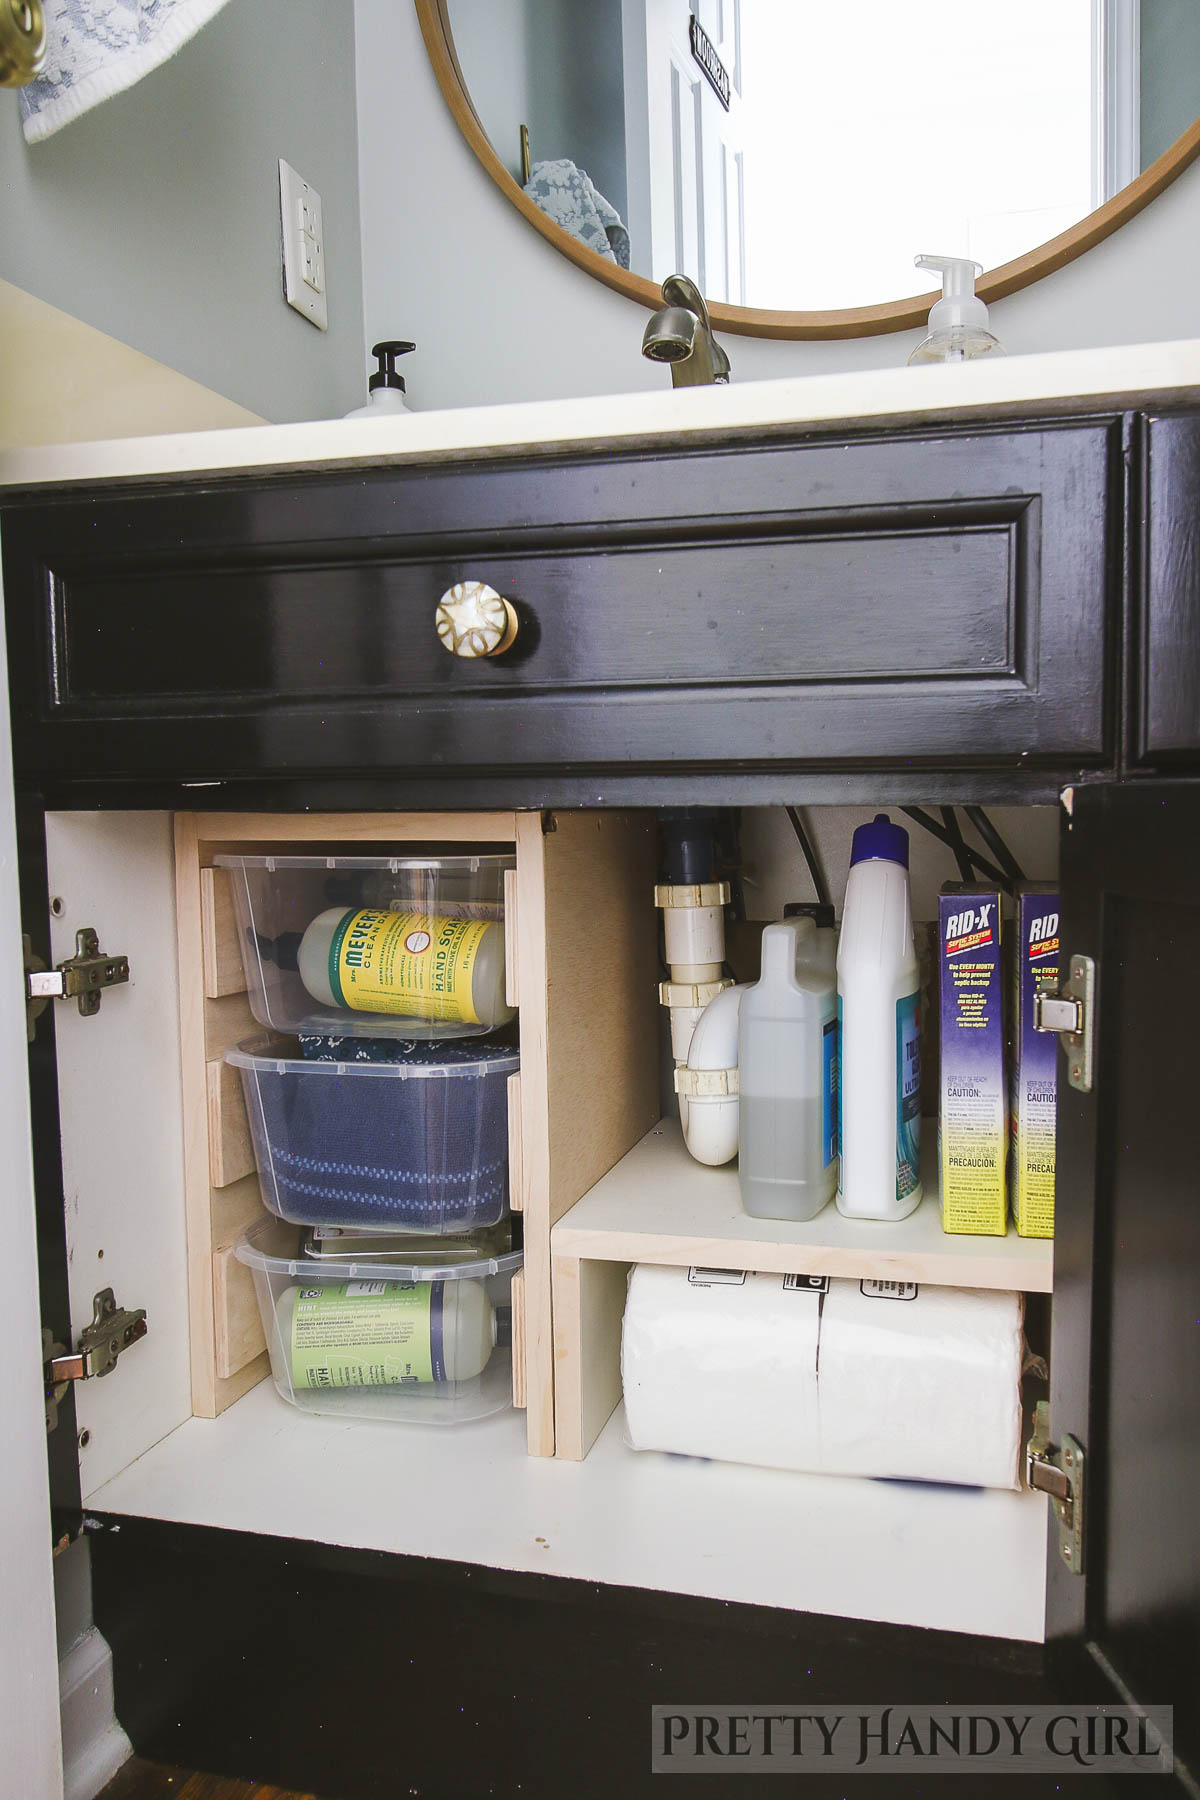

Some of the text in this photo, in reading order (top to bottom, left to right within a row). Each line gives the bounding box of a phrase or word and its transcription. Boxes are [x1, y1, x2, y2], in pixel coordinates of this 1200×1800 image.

[946, 904, 991, 939] RID-X
[1029, 913, 1059, 942] RID
[345, 910, 384, 968] MEYER'S
[364, 927, 381, 969] CLEAN
[435, 918, 463, 992] HAND SOAP
[448, 951, 457, 968] OLIVE
[947, 1088, 982, 1098] CAUTION:
[949, 1157, 997, 1168] PRECAUCIÓN:
